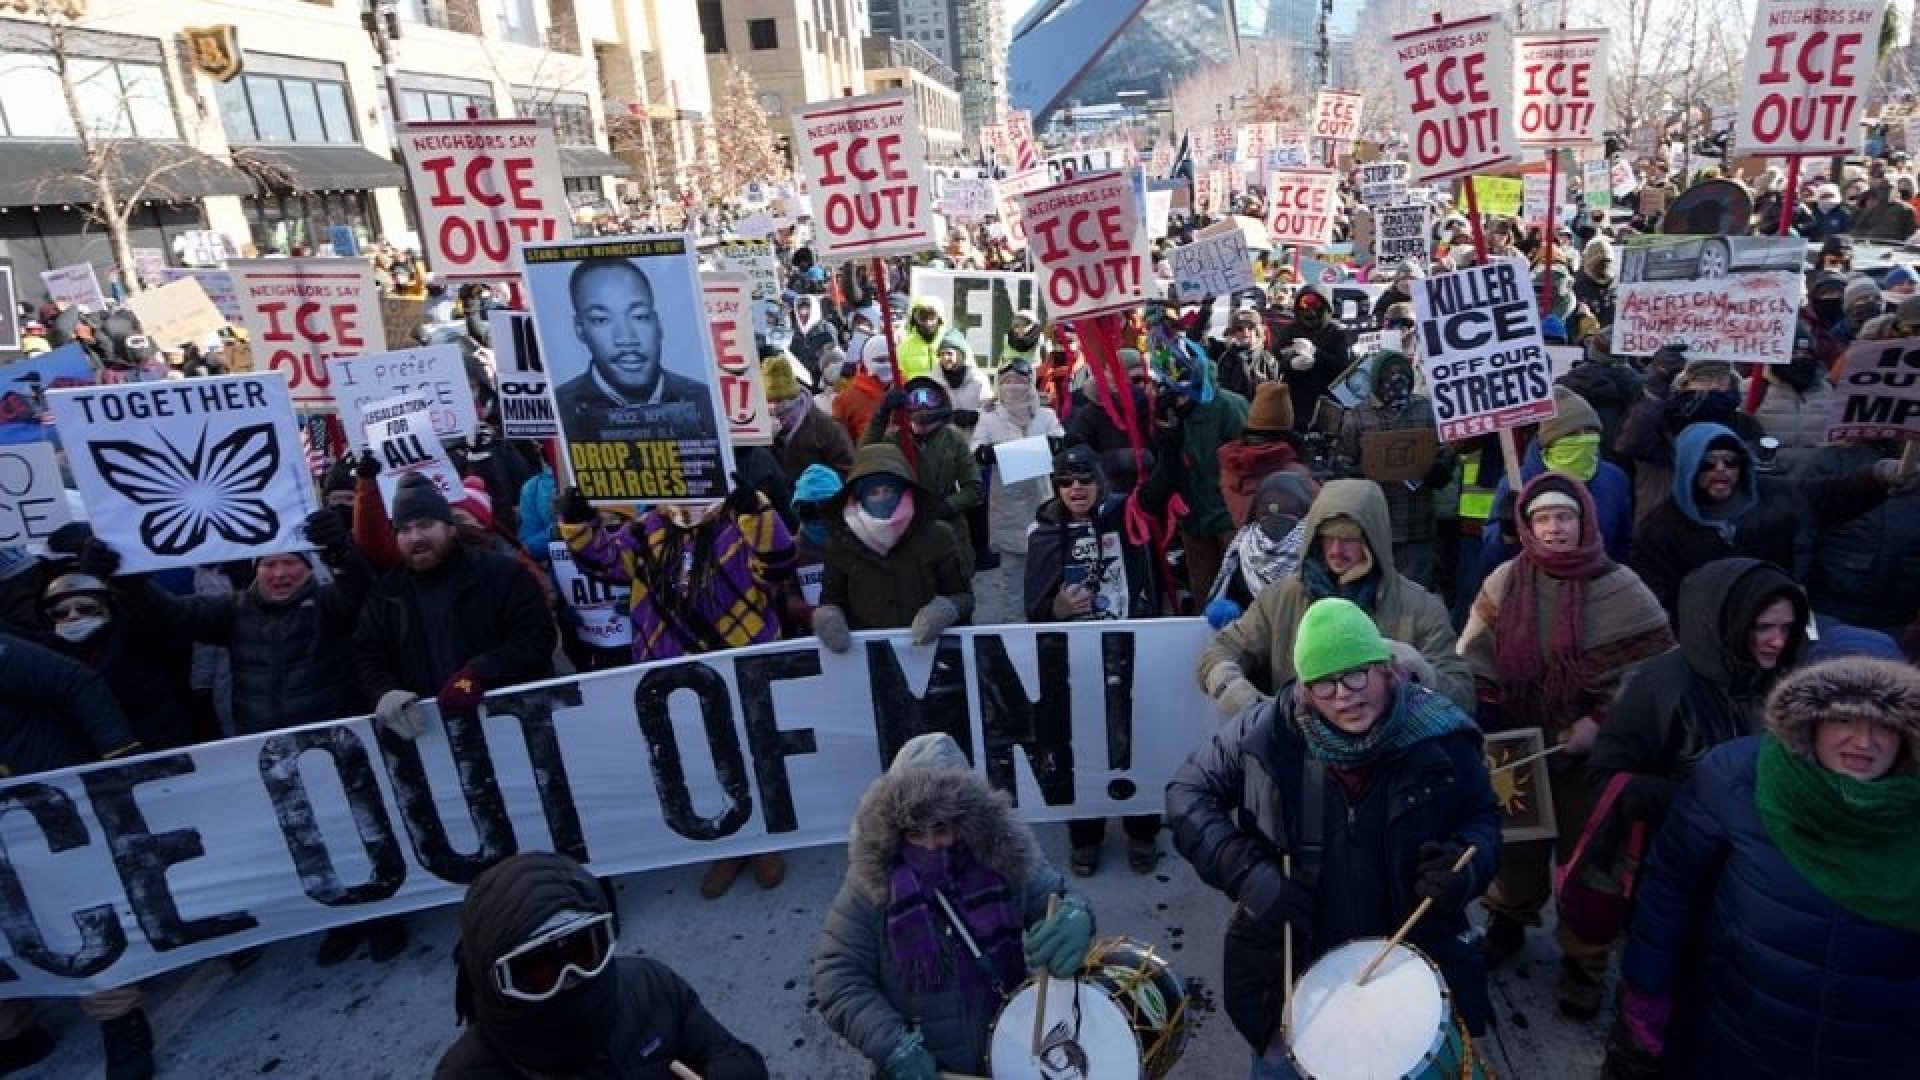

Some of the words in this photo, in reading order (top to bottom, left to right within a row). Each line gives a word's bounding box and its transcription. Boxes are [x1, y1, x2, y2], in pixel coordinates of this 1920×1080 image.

[1769, 9, 1845, 26] NEIGHBORS
[1849, 10, 1873, 24] SAY
[1398, 35, 1466, 61] NEIGHBORS
[1469, 32, 1489, 47] SAY
[1759, 31, 1862, 87] ICE
[1404, 52, 1490, 114] ICE
[1523, 62, 1591, 97] ICE
[808, 118, 879, 141] NEIGHBORS
[881, 115, 904, 129] SAY
[1320, 101, 1354, 120] ICE
[1521, 102, 1595, 135] OUT!
[1752, 93, 1857, 145] OUT!
[413, 136, 503, 151] NEIGHBORS
[509, 135, 537, 148] SAY
[1416, 108, 1499, 167] OUT!
[813, 134, 909, 187] ICE
[1363, 165, 1391, 182] STOP
[421, 155, 543, 211] ICE
[1278, 186, 1326, 213] ICE
[825, 185, 918, 236] OUT!
[1028, 190, 1097, 218] NEIGHBORS
[1100, 186, 1121, 199] SAY
[1034, 205, 1130, 264] ICE
[1273, 213, 1327, 240] OUT!
[249, 284, 331, 298] NEIGHBORS
[336, 286, 361, 298] SAY
[1050, 255, 1141, 307] OUT!
[1426, 264, 1519, 318] KILLER
[256, 301, 364, 347] ICE
[1422, 300, 1537, 357] ICE
[336, 361, 361, 387] I
[1432, 357, 1485, 381] OFF
[1489, 345, 1541, 368] OUR
[73, 381, 268, 424] TOGETHER
[1433, 362, 1548, 419] STREETS
[387, 417, 409, 436] FOR
[382, 433, 434, 469] ALL
[571, 442, 630, 469] DROP
[637, 441, 682, 468] THE
[577, 469, 687, 497] CHARGES
[0, 752, 258, 985] CE
[259, 681, 588, 907] OUT
[635, 648, 822, 841] OF
[866, 631, 1136, 809] MN!
